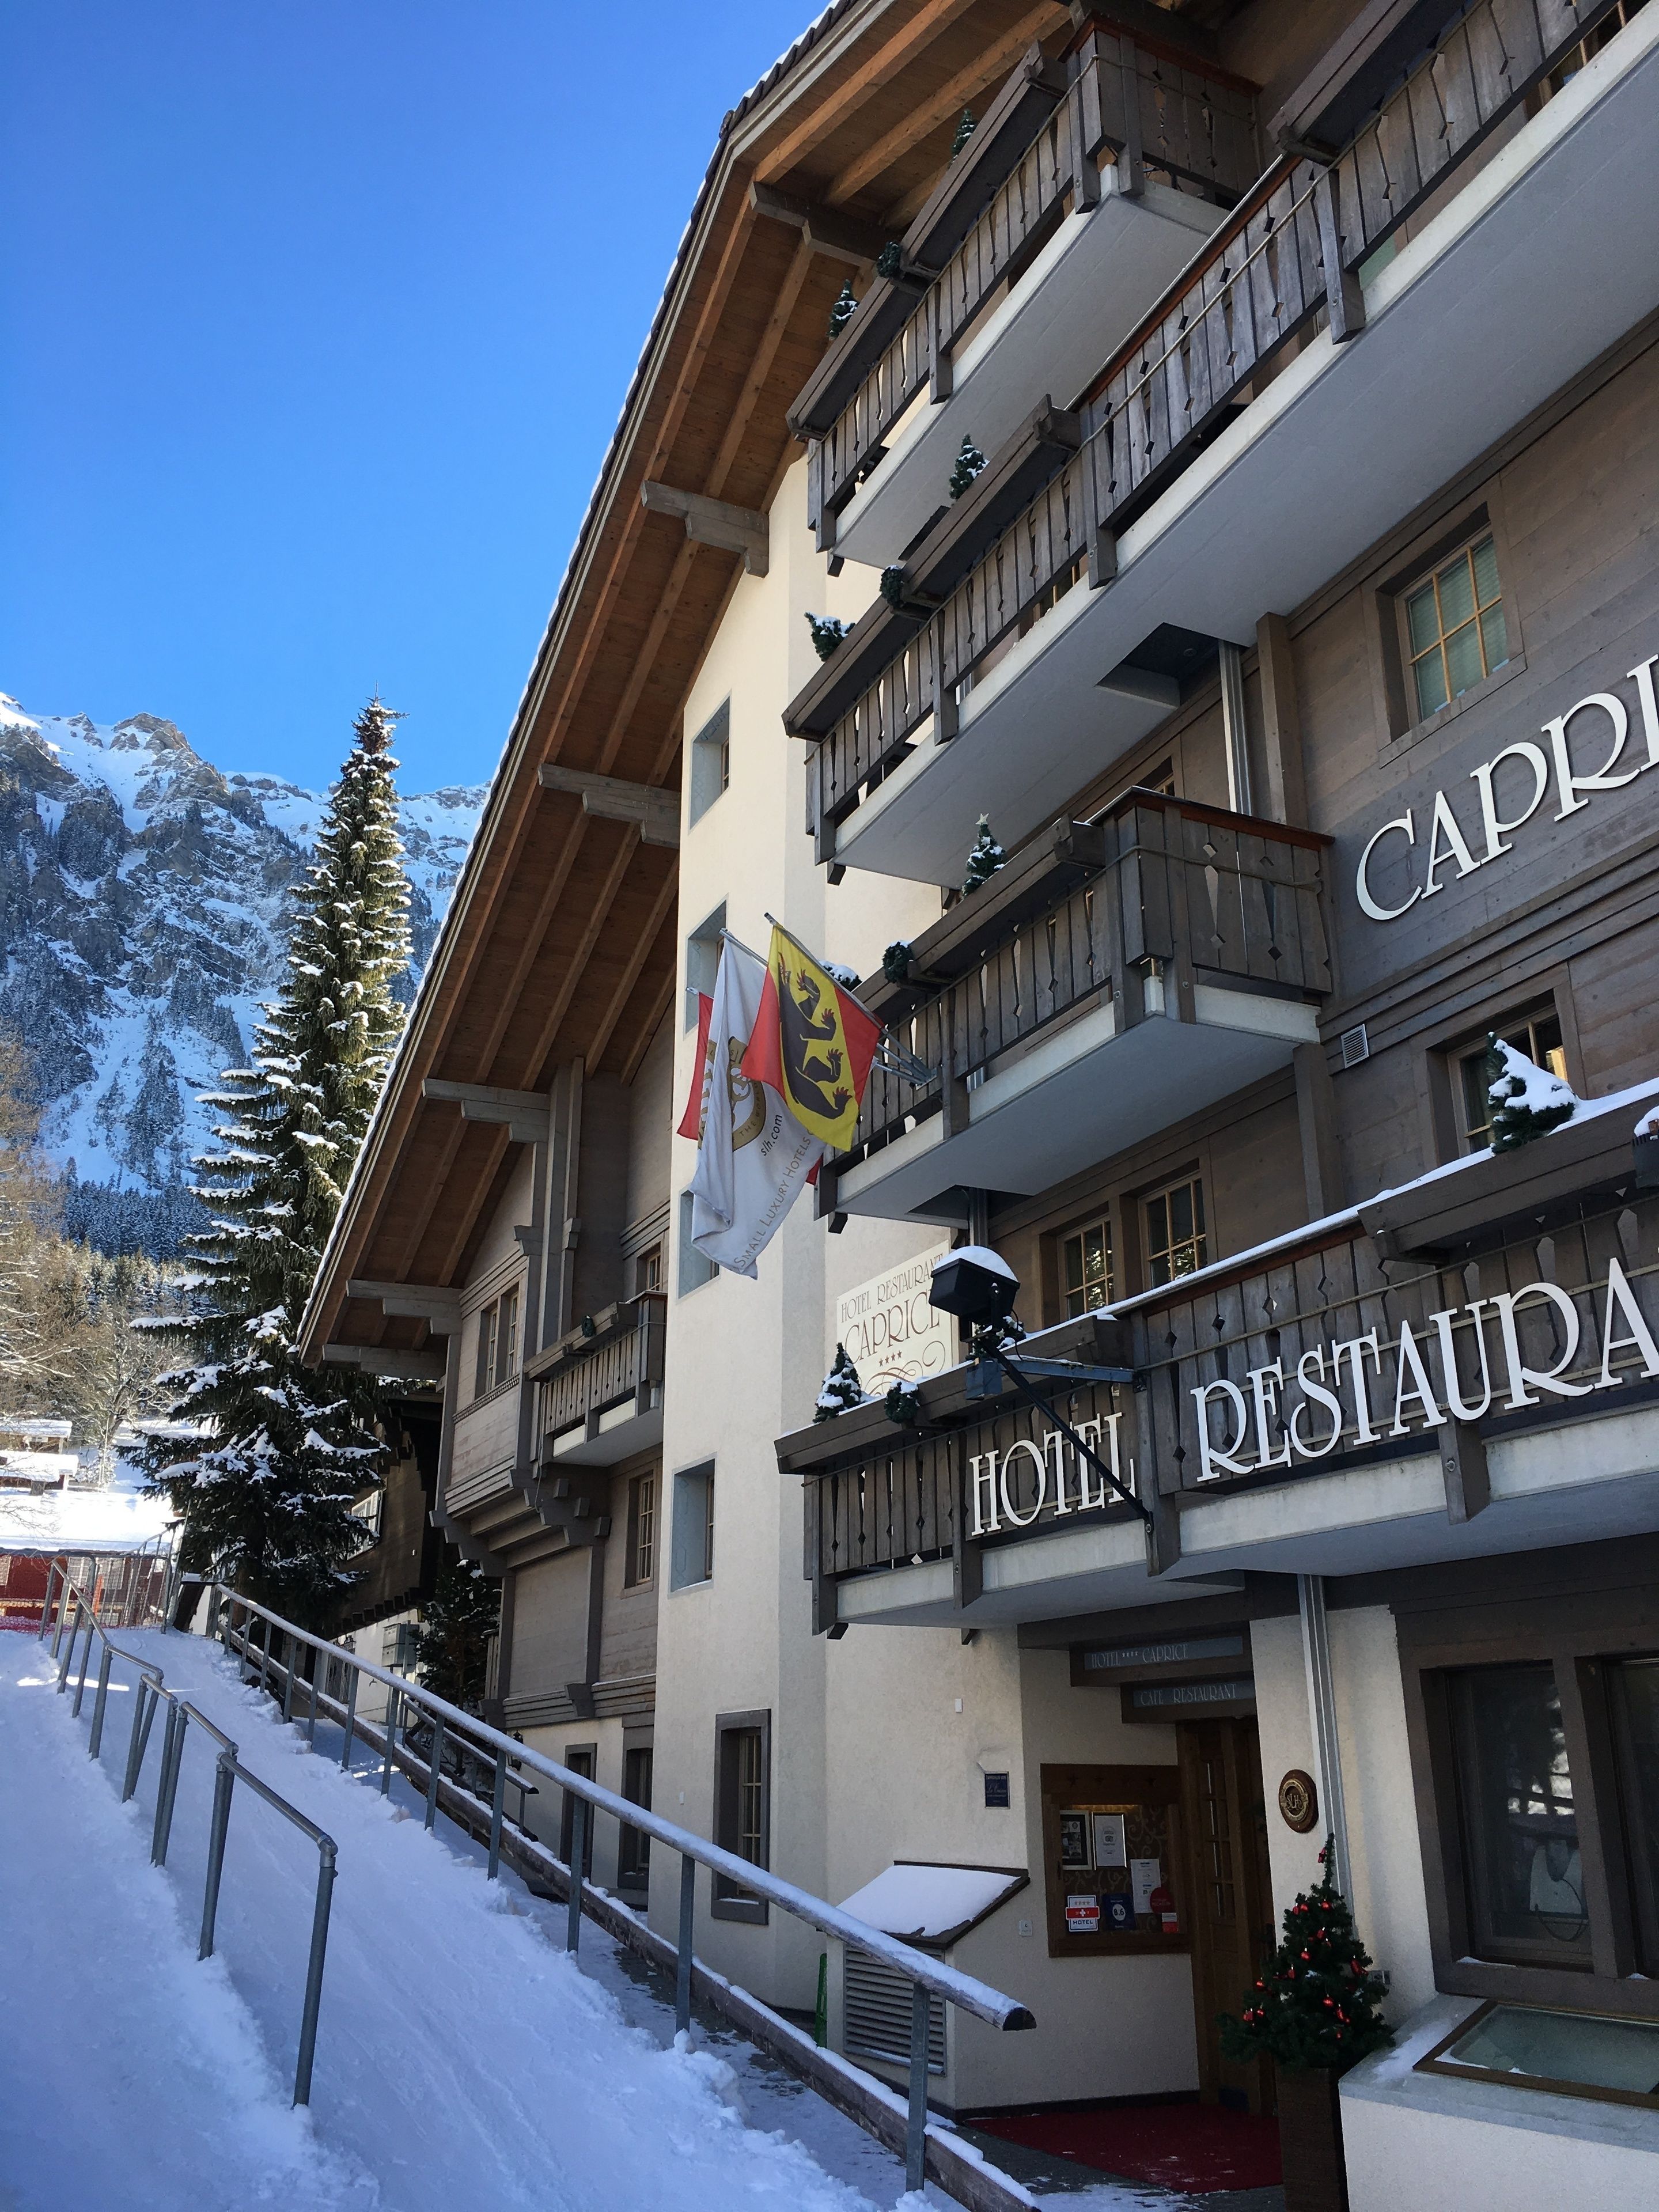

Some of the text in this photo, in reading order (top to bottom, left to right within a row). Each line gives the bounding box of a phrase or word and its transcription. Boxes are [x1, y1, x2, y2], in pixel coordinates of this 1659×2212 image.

[761, 1114, 783, 1157] slh.com
[841, 1290, 872, 1323] HOTEL
[969, 1257, 1659, 1537] HOTEL RESTAURA
[1092, 1643, 1188, 1668] HOTEL CAPRICE
[1173, 1683, 1237, 1705] RESTAURANT
[1113, 1908, 1124, 1916] 8.6
